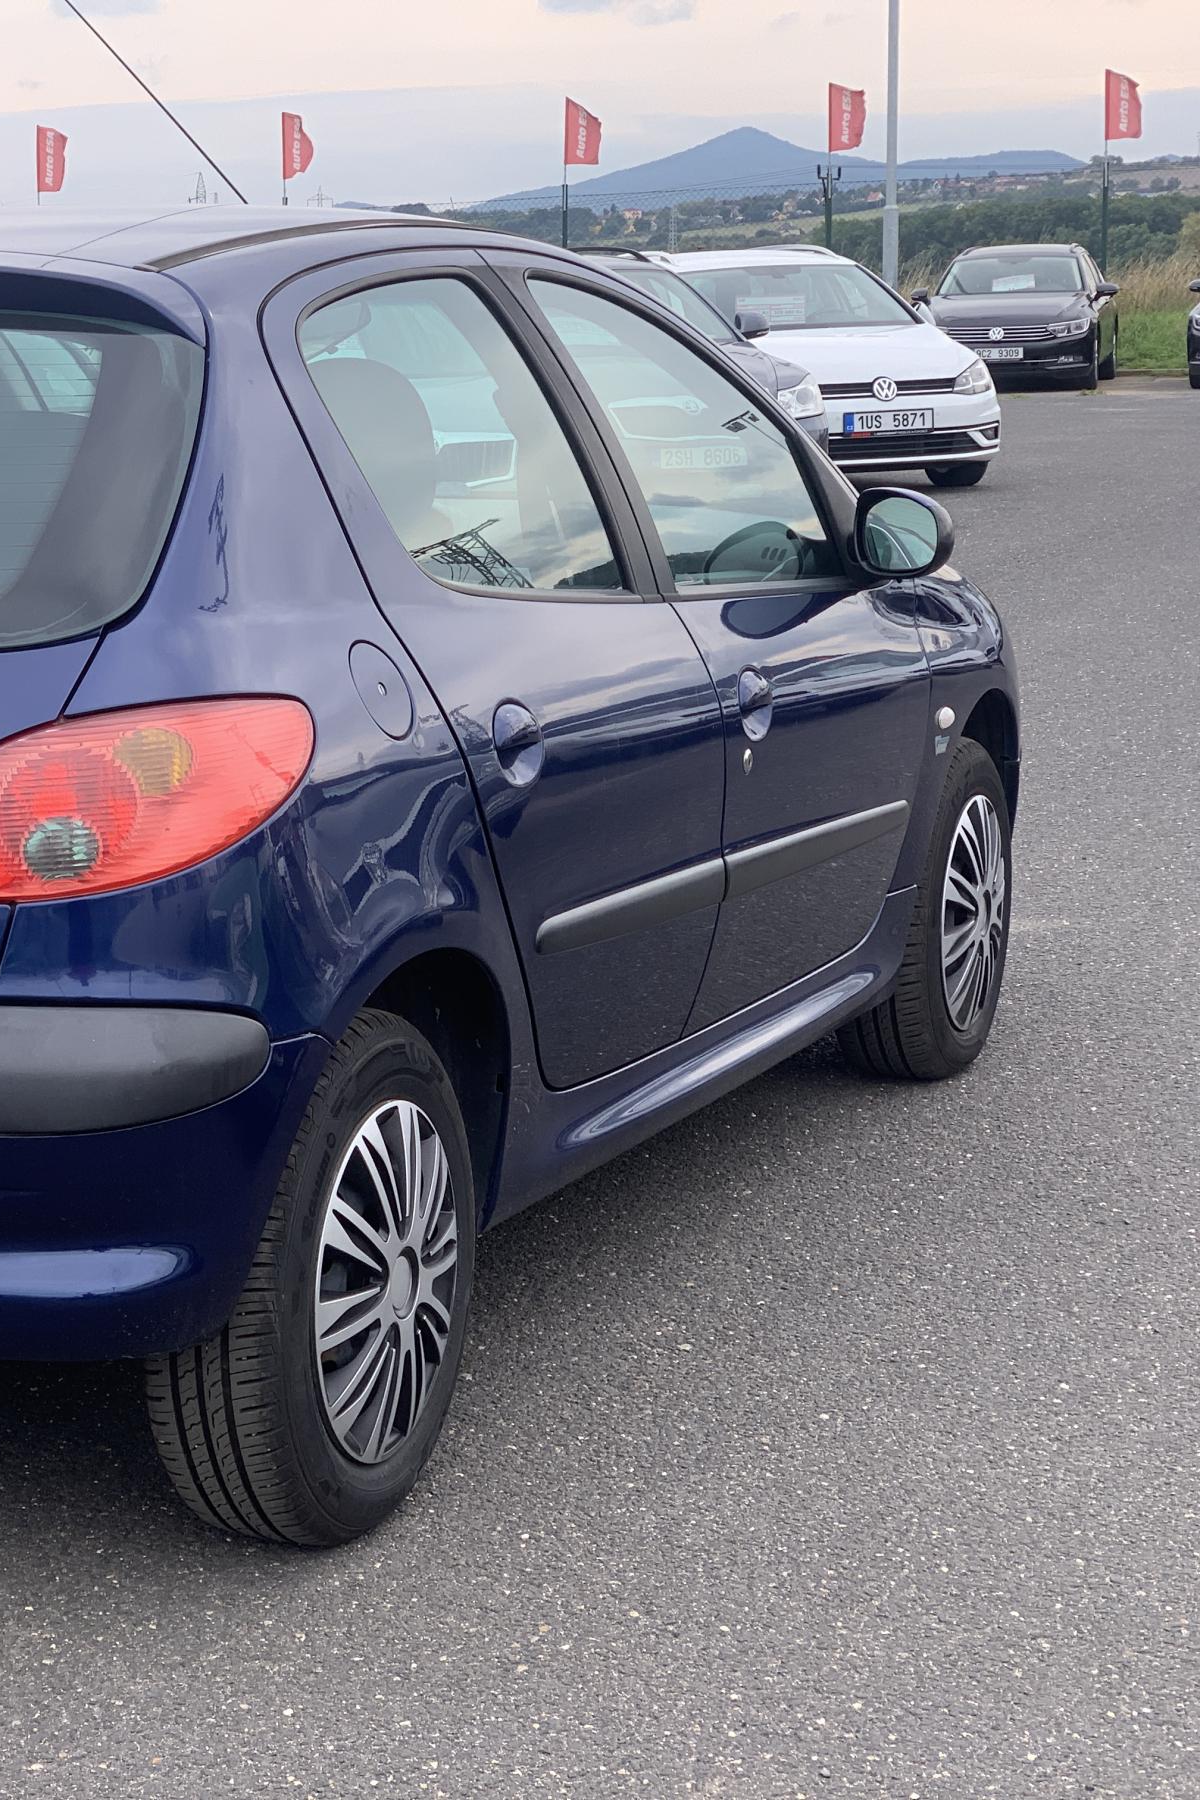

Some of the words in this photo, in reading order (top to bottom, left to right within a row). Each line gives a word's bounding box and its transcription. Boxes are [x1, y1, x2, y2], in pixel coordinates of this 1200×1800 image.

[841, 112, 851, 144] Auto
[1119, 100, 1128, 132] Auto
[46, 131, 55, 154] ESA
[292, 140, 300, 170] Auto
[576, 126, 586, 159] Auto
[45, 155, 53, 186] Auto
[998, 349, 1020, 357] 9309
[858, 415, 882, 430] 1US
[893, 412, 926, 427] 5871
[665, 450, 693, 467] 2SH
